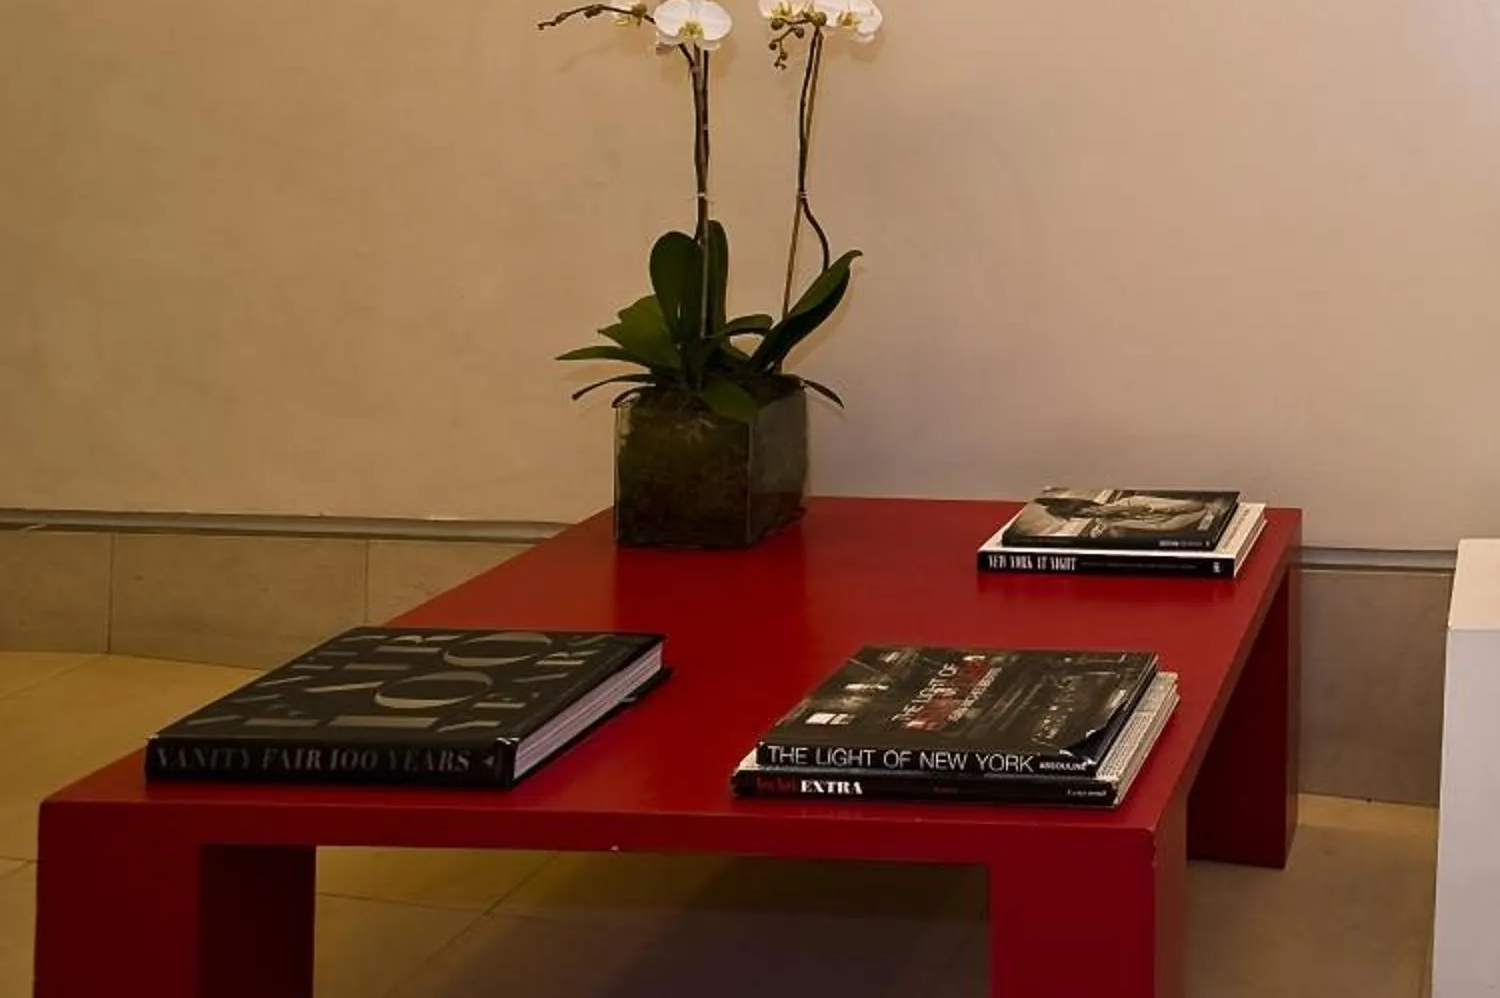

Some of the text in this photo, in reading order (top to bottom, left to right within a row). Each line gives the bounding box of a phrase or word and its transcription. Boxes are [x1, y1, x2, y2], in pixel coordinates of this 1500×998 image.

[157, 746, 472, 772] VANITY FAIR 100 YEARS
[767, 745, 809, 765] THE
[815, 747, 877, 767] LIGHT
[883, 749, 912, 769] OF
[918, 751, 968, 771] NEW
[975, 753, 1034, 773] YORK
[800, 779, 863, 795] EXTRA
